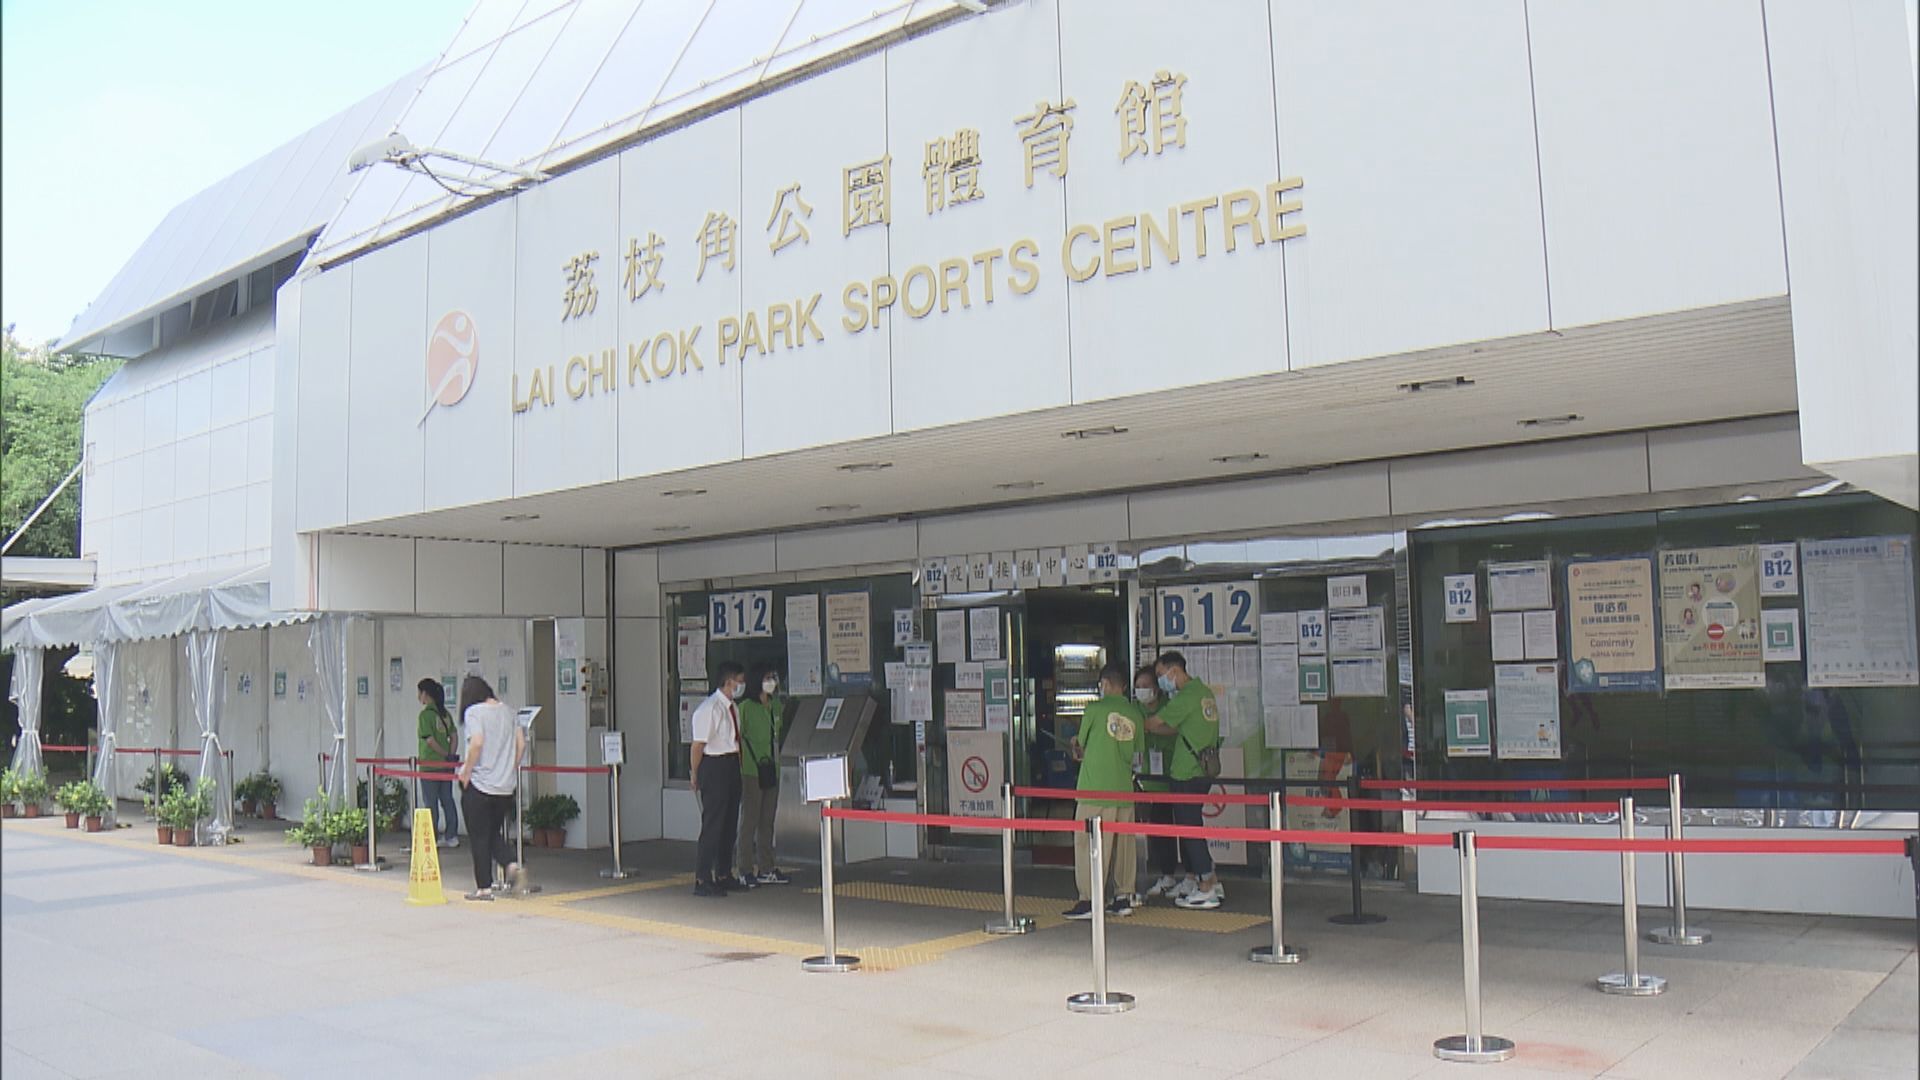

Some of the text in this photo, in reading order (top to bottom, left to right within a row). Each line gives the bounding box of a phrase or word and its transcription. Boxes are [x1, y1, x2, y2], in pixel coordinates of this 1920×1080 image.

[562, 71, 1188, 322] 荔枝角公園體育館
[512, 176, 1308, 414] LAI CHI KOK PARK SPORTS CENTRE
[926, 553, 1116, 584] B12 疫苗接種中心 B12
[1763, 559, 1793, 578] B12
[1448, 589, 1473, 606] B12
[712, 596, 768, 635] B12
[1163, 589, 1252, 637] B12
[896, 620, 912, 634] B12
[1301, 623, 1323, 638] B12
[1589, 637, 1635, 650] Comirnaty
